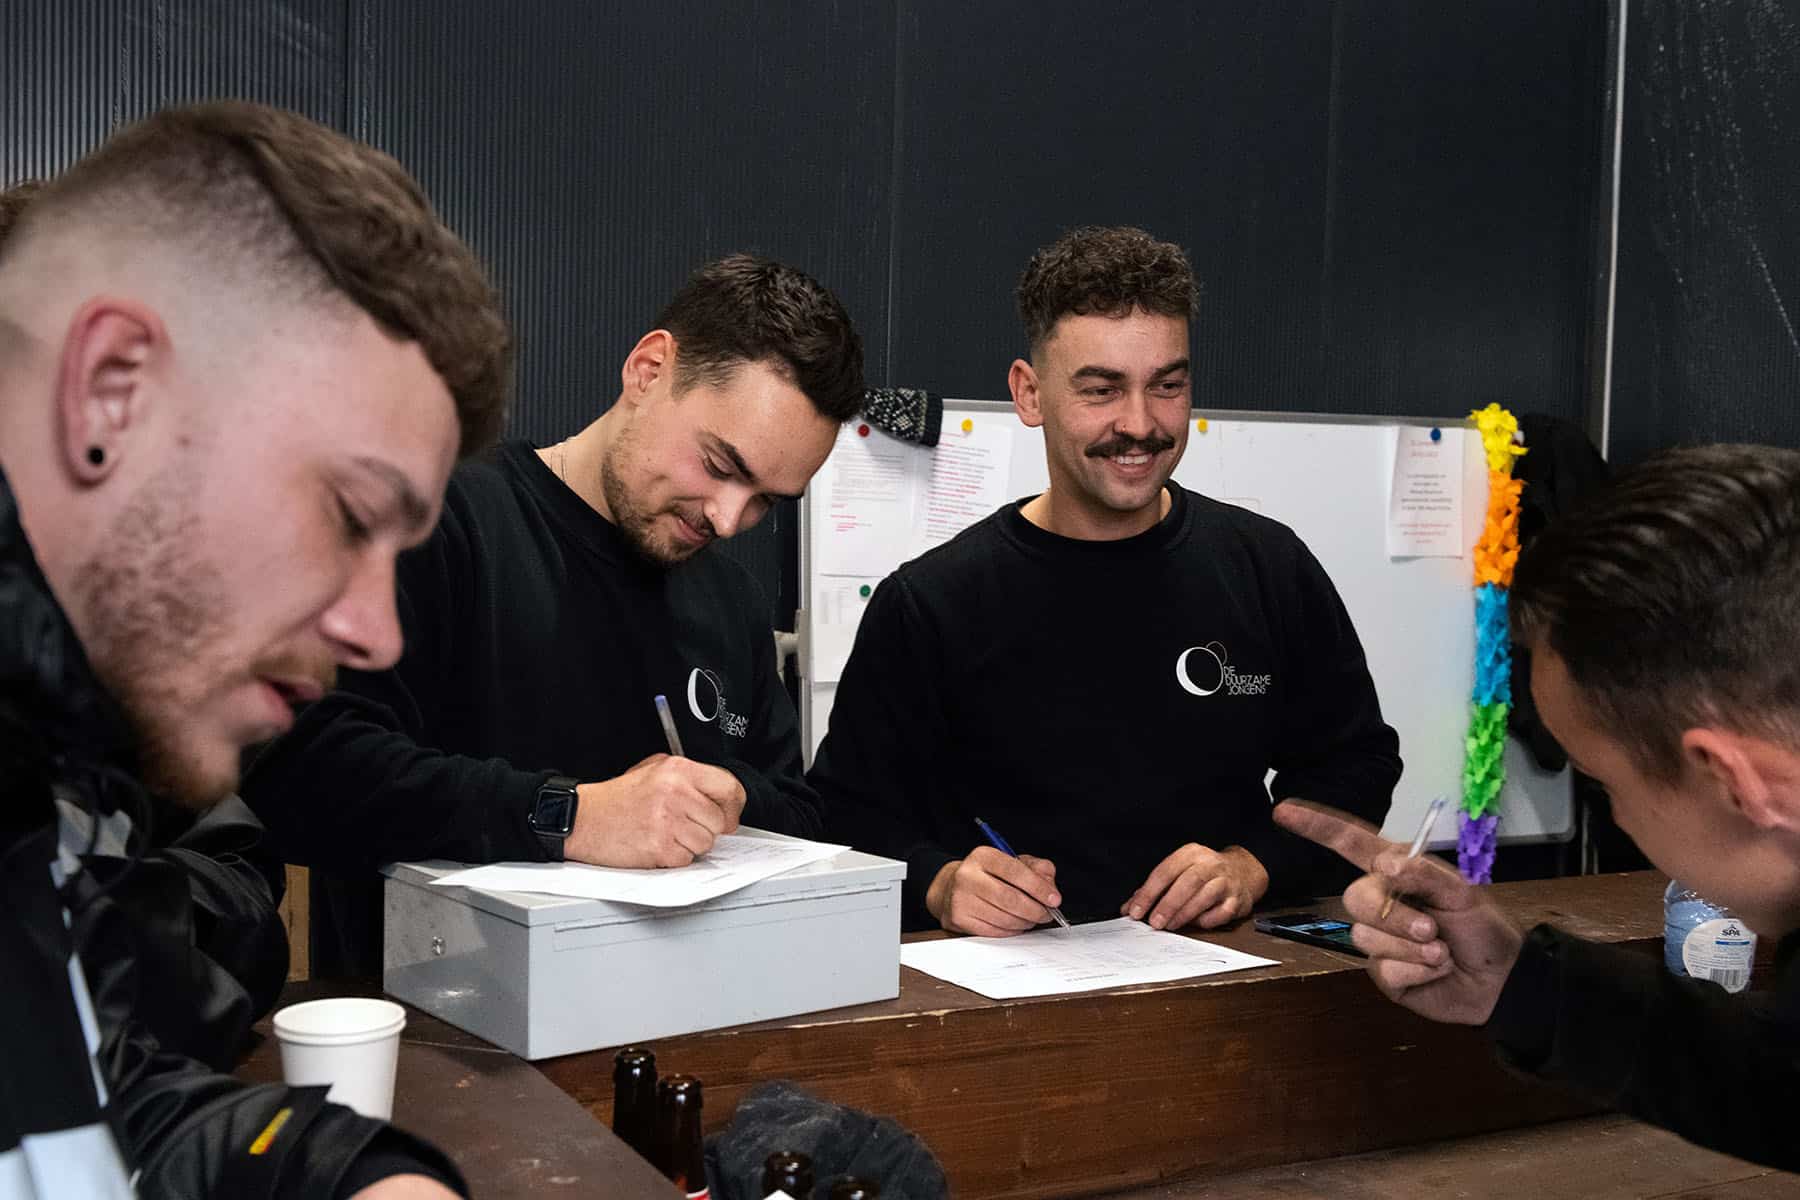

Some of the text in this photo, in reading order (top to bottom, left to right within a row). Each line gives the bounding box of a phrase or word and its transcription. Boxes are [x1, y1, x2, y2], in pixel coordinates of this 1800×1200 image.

[1224, 666, 1236, 676] DE
[1225, 675, 1271, 686] DUURZAME
[1228, 685, 1266, 695] JONGENS
